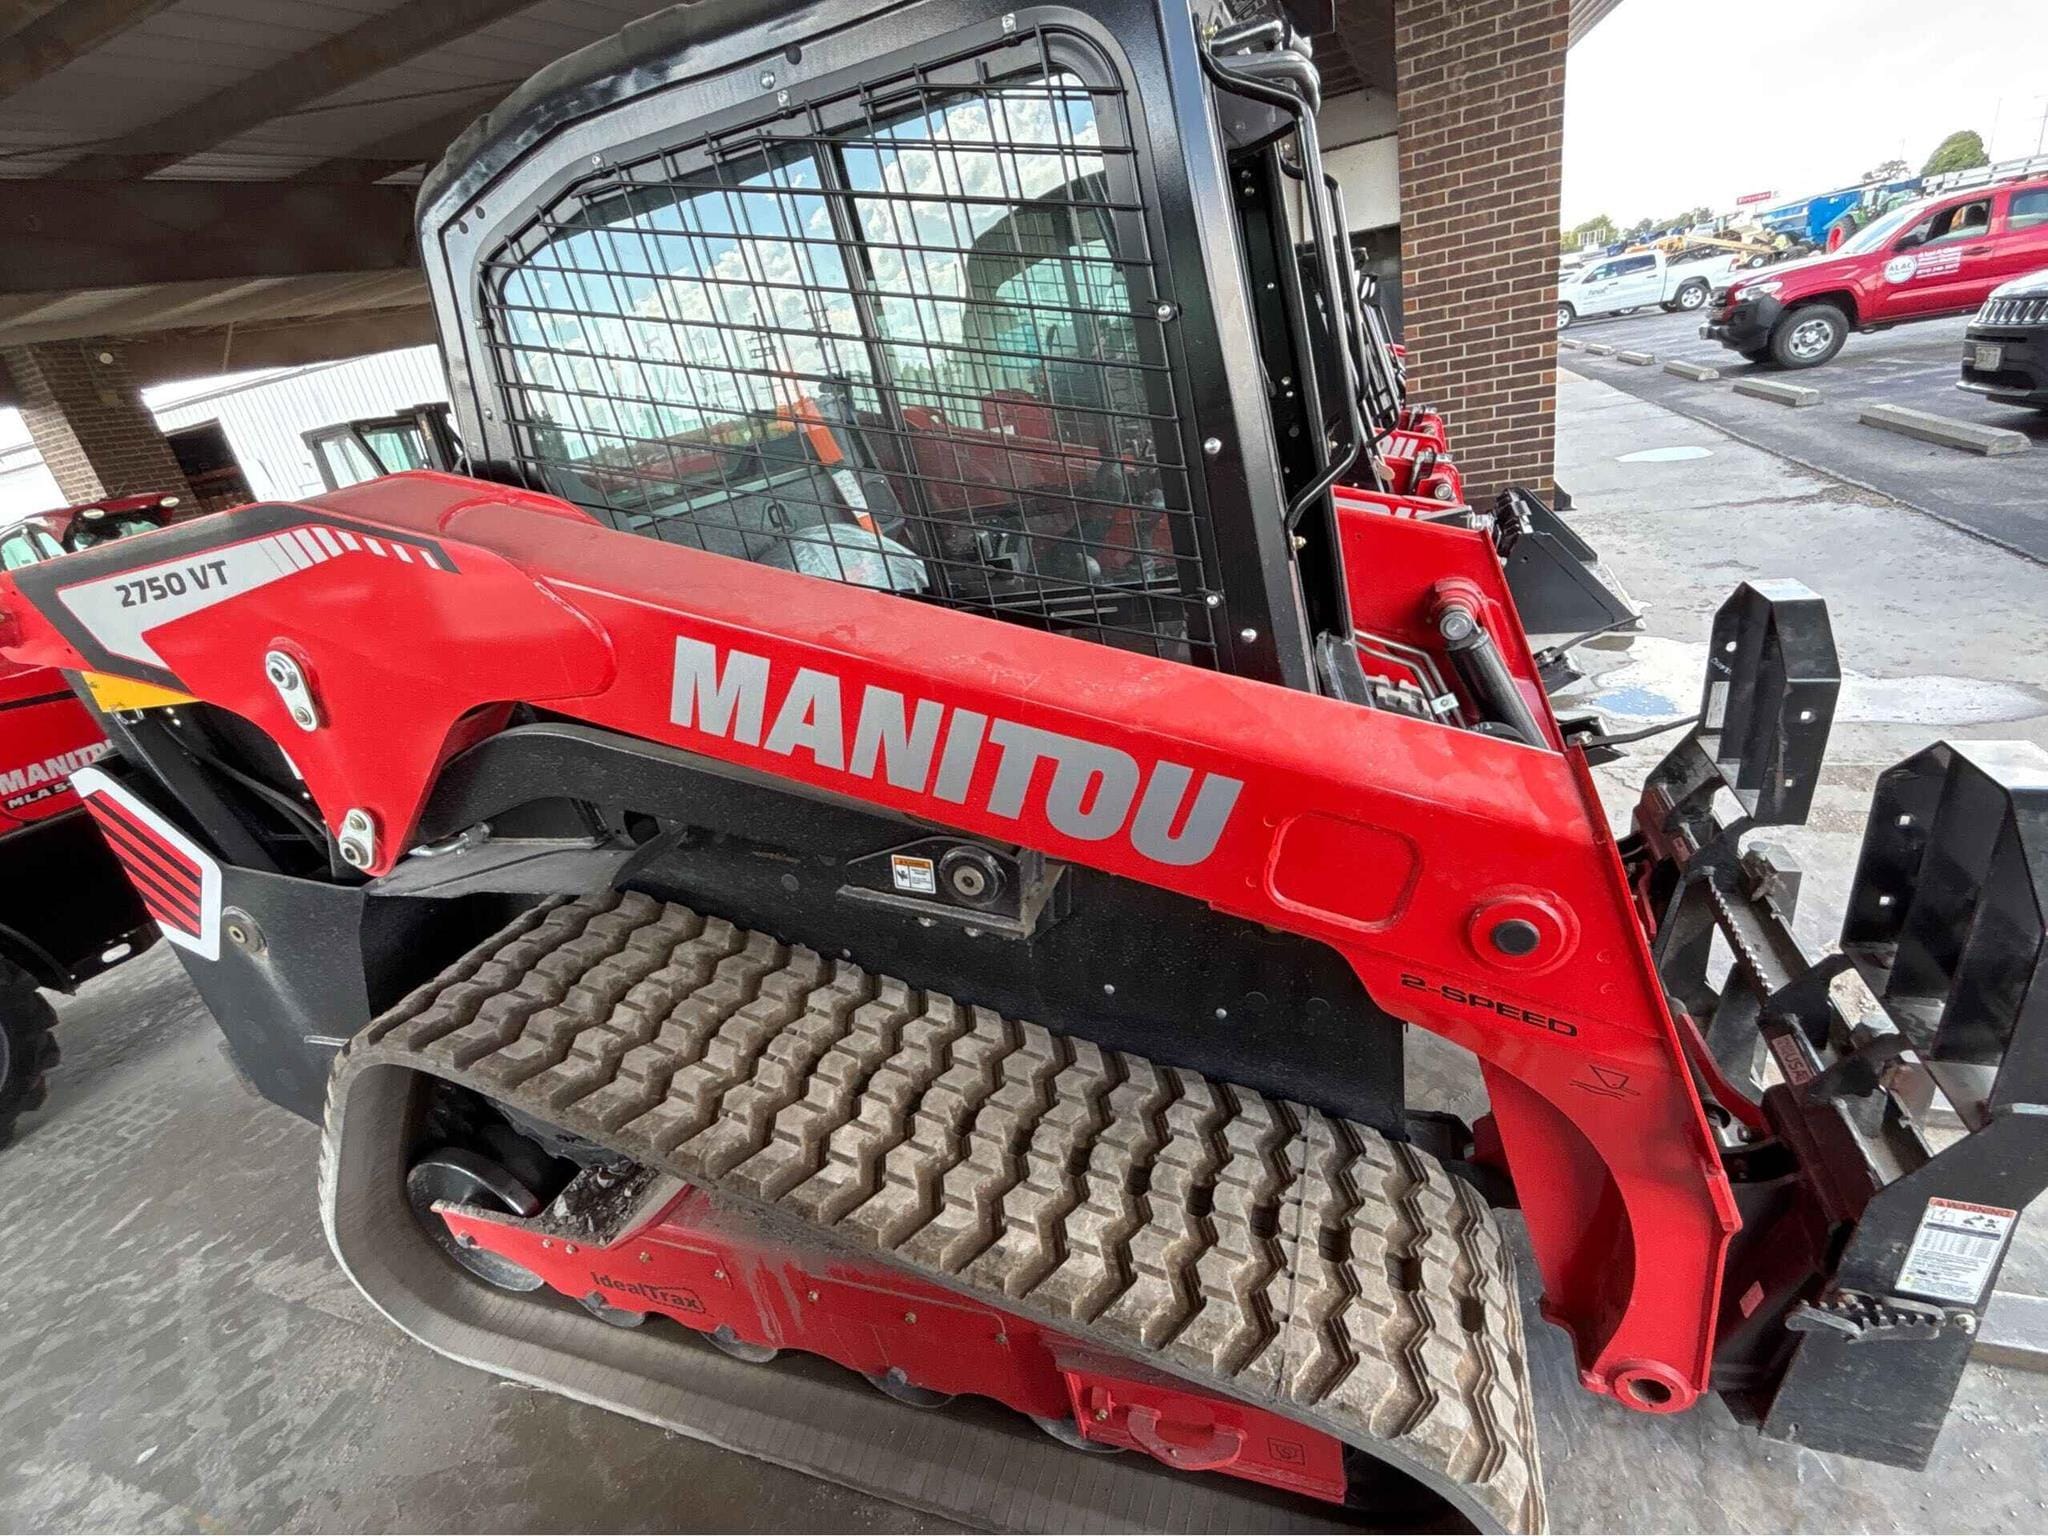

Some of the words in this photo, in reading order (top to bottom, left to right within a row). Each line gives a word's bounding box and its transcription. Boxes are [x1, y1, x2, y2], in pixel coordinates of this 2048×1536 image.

[114, 571, 187, 608] 2750
[186, 560, 228, 590] VT
[0, 739, 114, 796] MANITO
[669, 635, 1245, 867] MANITOU
[8, 788, 52, 809] MLA
[1400, 973, 1578, 1037] 2-SPEED
[590, 1271, 700, 1309] IdealTrax
